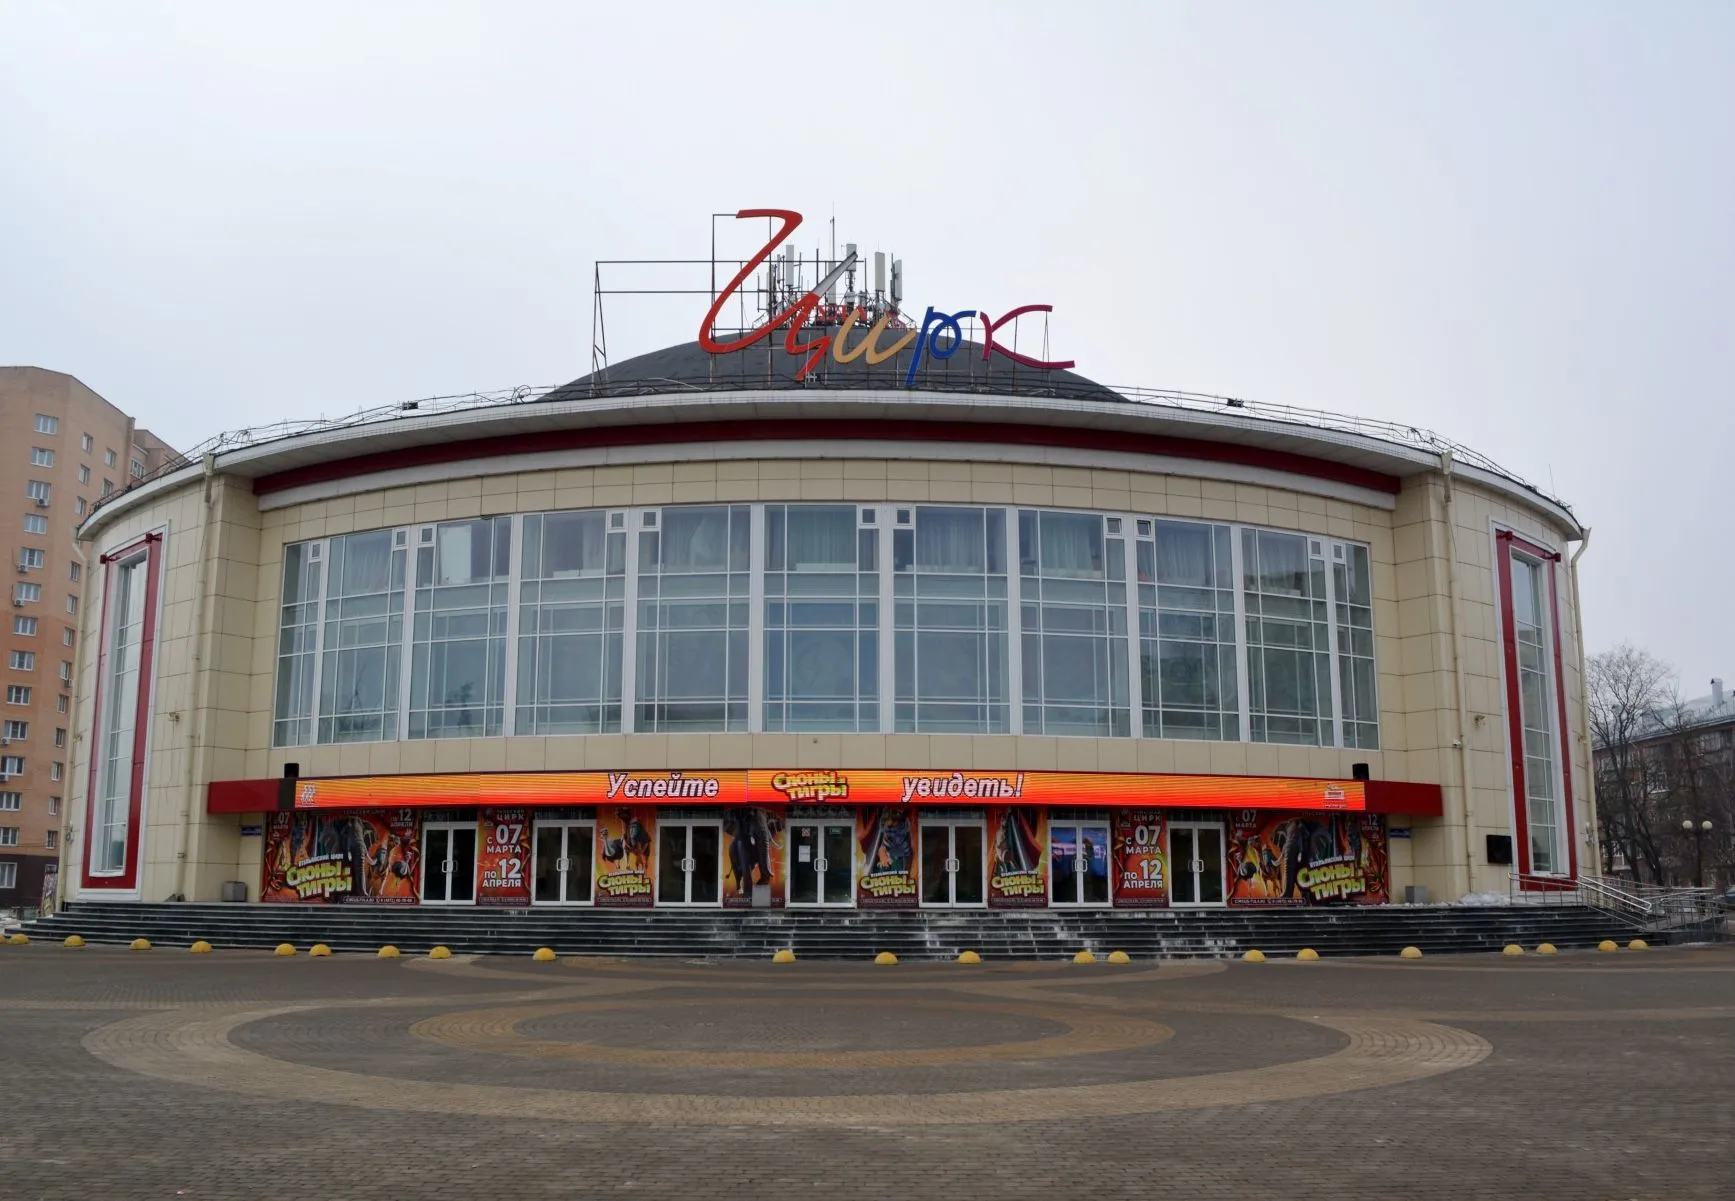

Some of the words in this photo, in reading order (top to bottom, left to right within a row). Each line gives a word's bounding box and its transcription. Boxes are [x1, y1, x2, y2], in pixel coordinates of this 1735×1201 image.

[698, 208, 1076, 387] Цирк
[607, 772, 719, 799] Успейте
[901, 773, 1024, 803] увидеть!
[399, 809, 411, 821] 12
[1242, 810, 1257, 822] 07
[495, 824, 522, 844] 07
[1135, 825, 1161, 845] 07
[486, 845, 521, 853] МАРТА
[287, 861, 342, 886] Слоны
[499, 858, 522, 878] 12
[1140, 859, 1162, 880] 12
[1297, 863, 1355, 888] Слоны
[482, 879, 521, 887] АПРЕЛЯ
